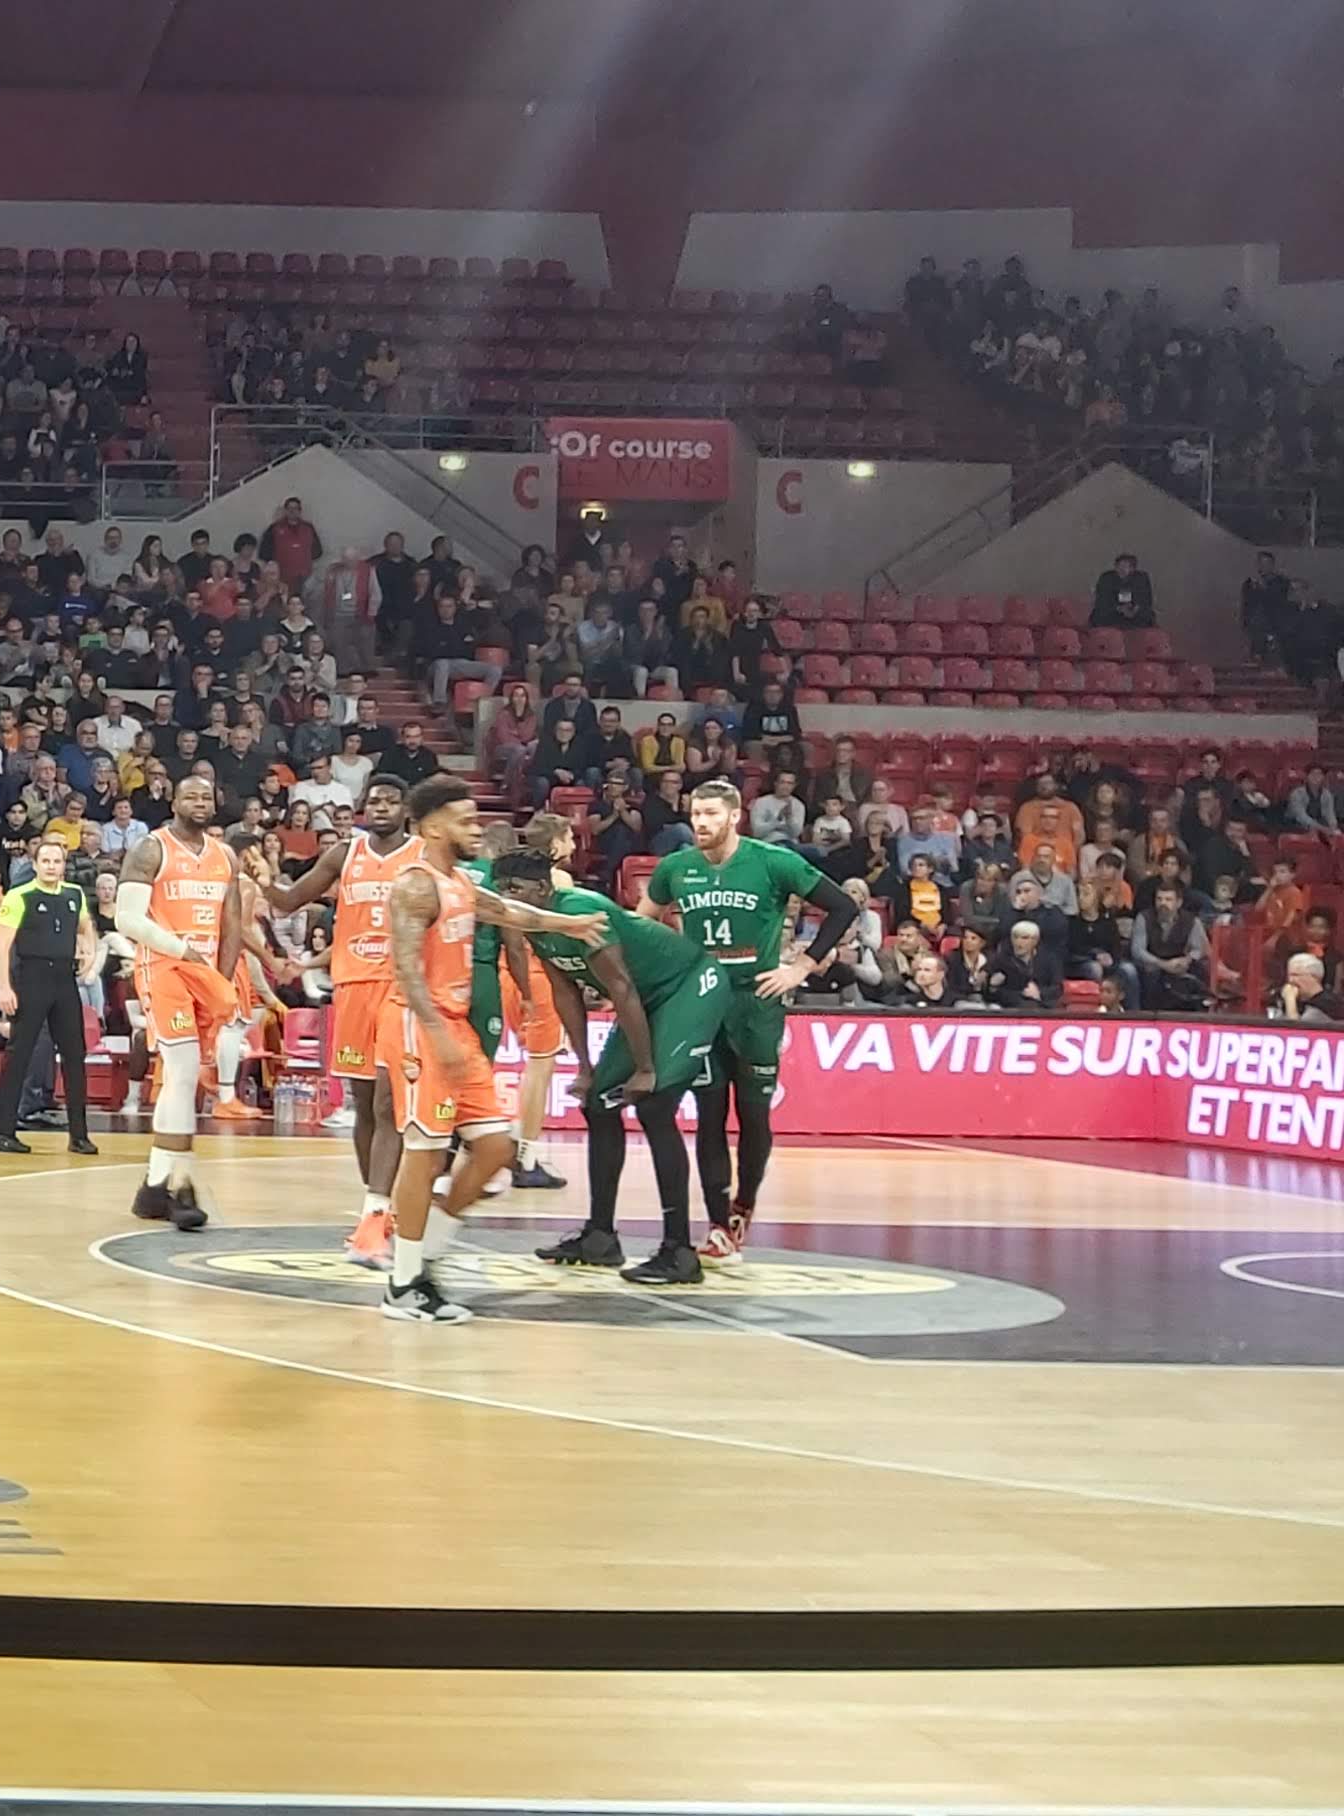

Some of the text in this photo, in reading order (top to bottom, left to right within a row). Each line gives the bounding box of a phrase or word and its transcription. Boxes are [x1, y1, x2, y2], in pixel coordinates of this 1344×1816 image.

[608, 438, 713, 460] course
[513, 465, 540, 510] C
[776, 470, 803, 515] C
[677, 889, 760, 914] LIMOGES
[370, 906, 385, 928] 5
[702, 918, 733, 946] 14
[698, 967, 719, 997] 16
[810, 1021, 1162, 1078] VA VITE SUR
[1186, 1084, 1242, 1137] ET
